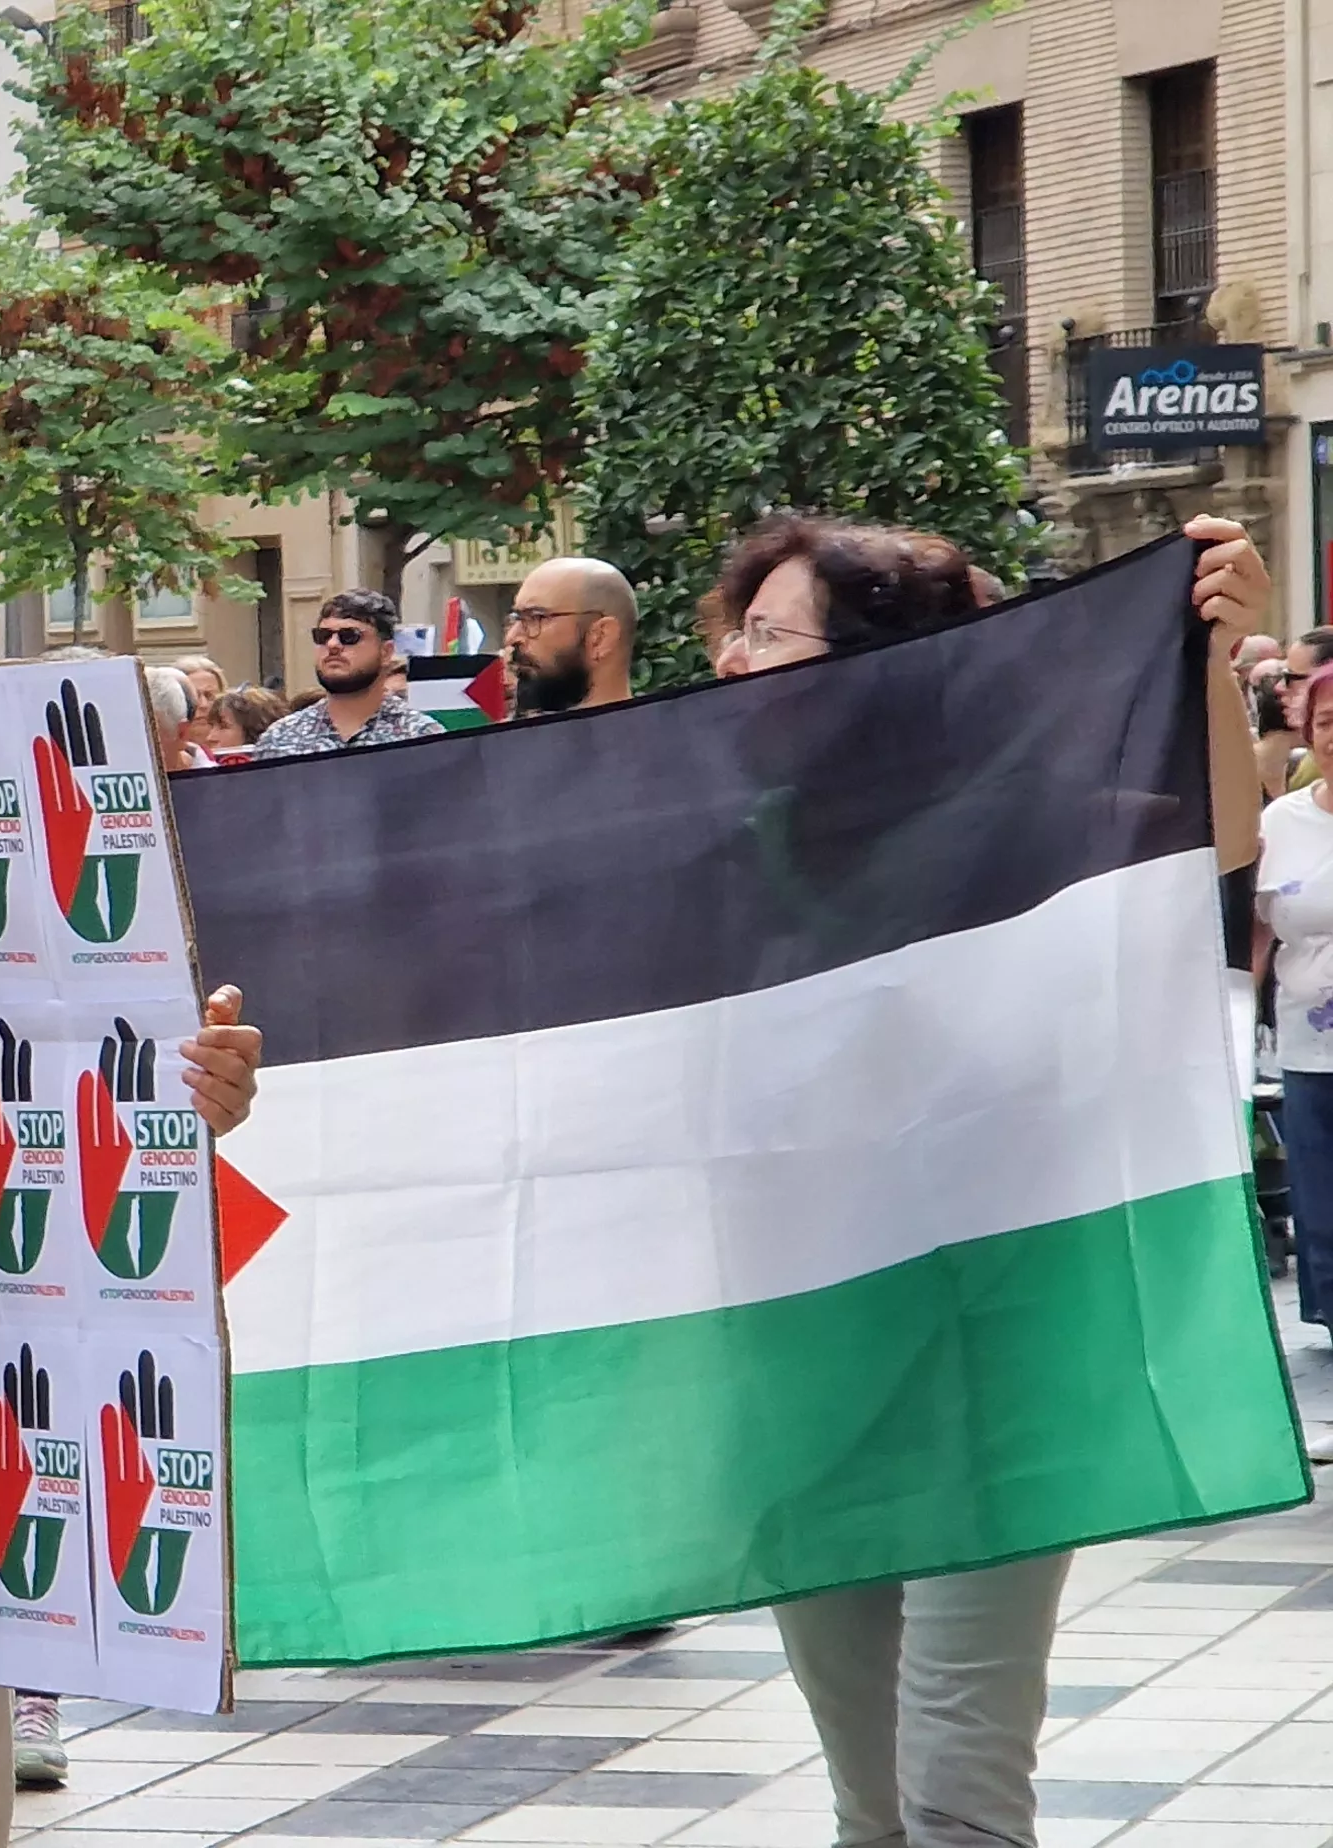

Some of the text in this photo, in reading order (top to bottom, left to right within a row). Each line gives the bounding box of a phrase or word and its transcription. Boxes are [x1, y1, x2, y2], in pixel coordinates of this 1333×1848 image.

[1104, 377, 1260, 416] Arenas
[1104, 421, 1151, 435] CENTRO
[1207, 418, 1260, 431] AUDITIVO
[94, 776, 149, 812] STOP
[101, 814, 152, 829] GENOCIDIO
[103, 833, 156, 849] PALESTINO
[18, 1112, 64, 1147] STOP
[136, 1112, 197, 1147] STOP
[22, 1151, 64, 1165] GENOCIDIO
[140, 1151, 197, 1166] GENOCIDIO
[22, 1169, 65, 1185] PALESTINO
[140, 1170, 198, 1186] PALESTINO
[35, 1441, 80, 1477] STOP
[158, 1451, 212, 1488] STOP
[37, 1478, 79, 1496] GENOCIDIO
[37, 1497, 80, 1515] PALESTINO
[161, 1489, 211, 1507] GENOCIDIO
[160, 1508, 211, 1527] PALESTINO
